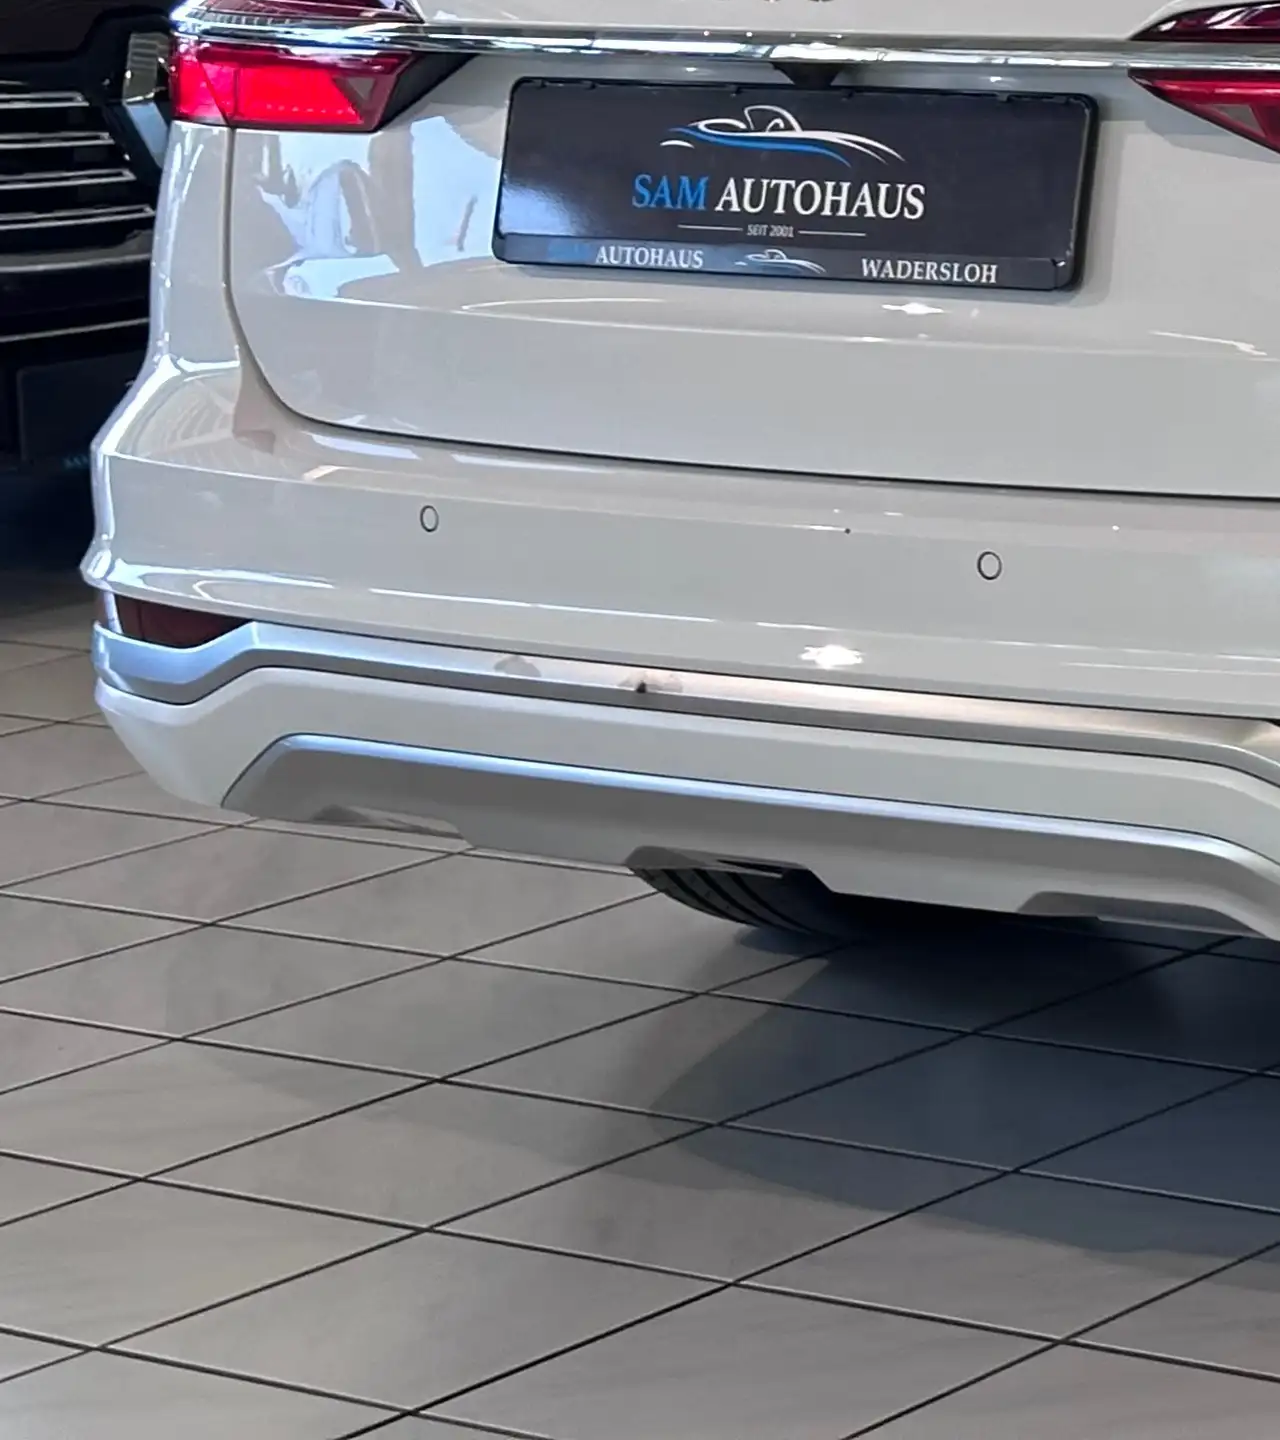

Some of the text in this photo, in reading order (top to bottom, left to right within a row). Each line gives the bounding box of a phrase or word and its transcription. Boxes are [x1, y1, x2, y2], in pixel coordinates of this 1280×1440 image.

[631, 173, 926, 221] SAM AUTOHAUS
[746, 224, 769, 237] SEIT
[594, 245, 704, 269] AUTOHAUS
[861, 257, 998, 284] WADERSLOH
